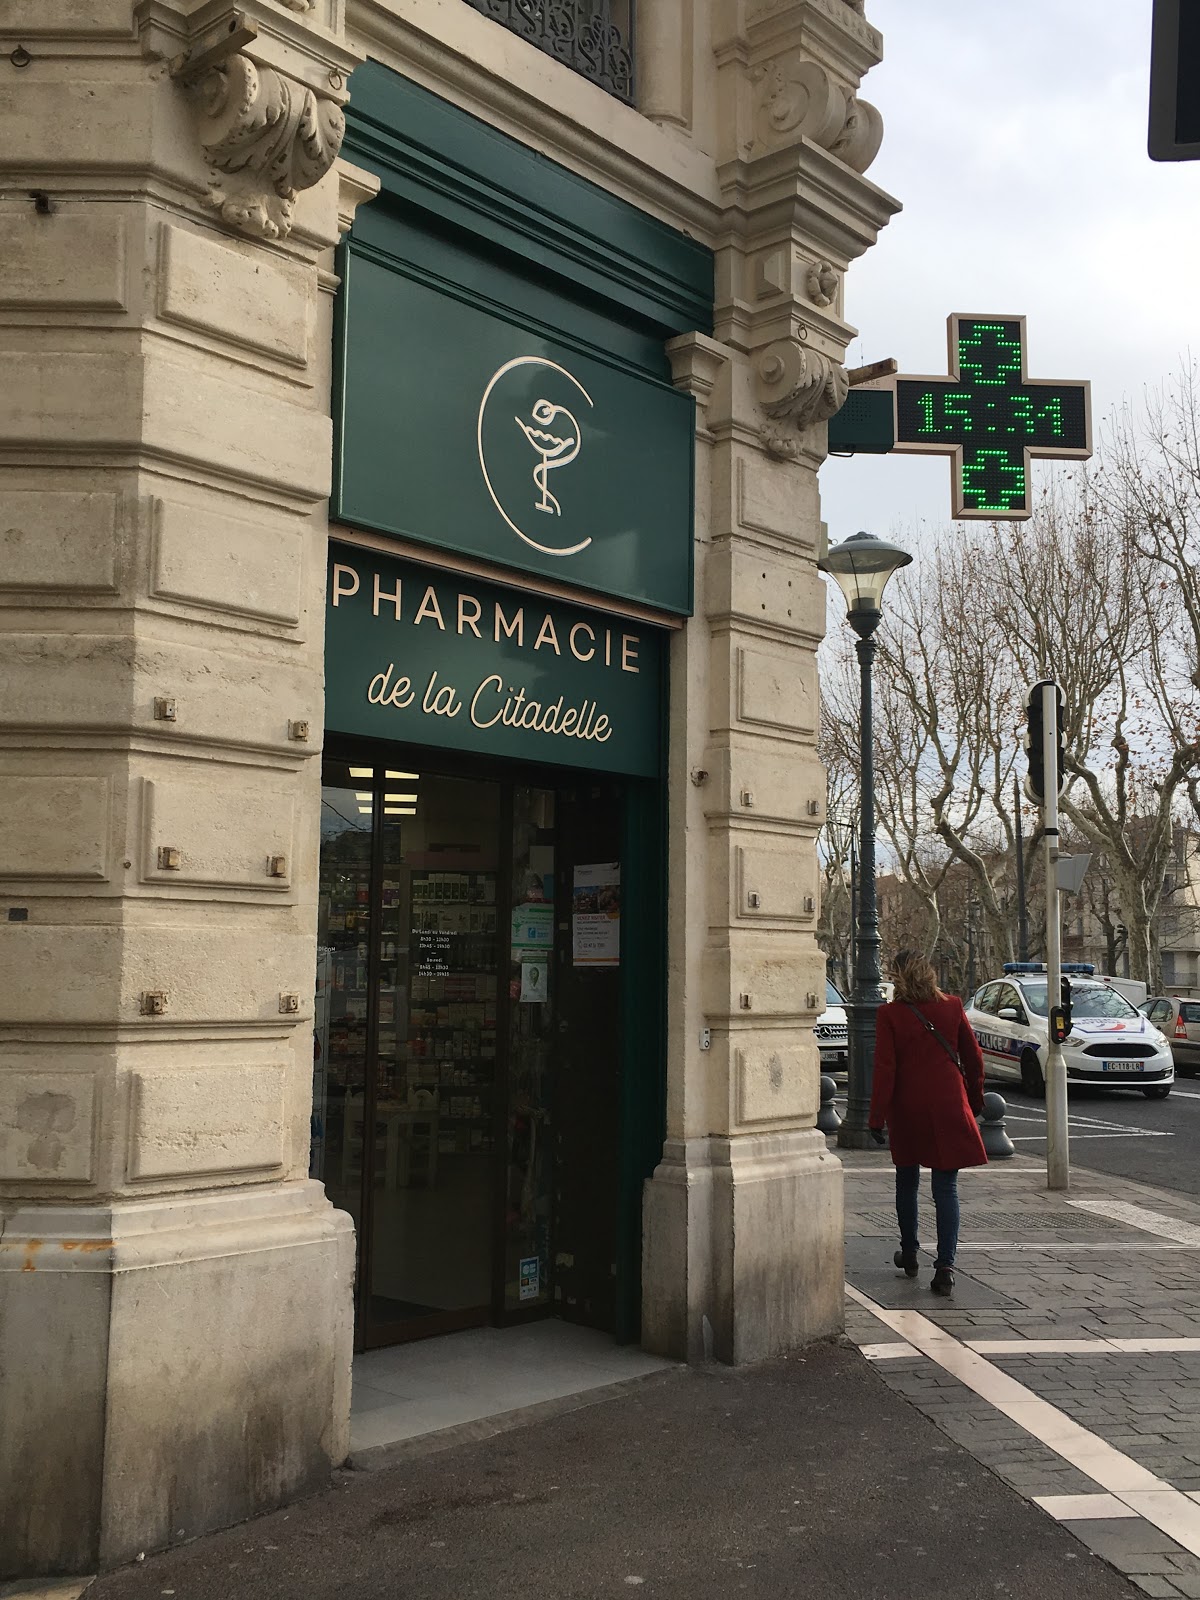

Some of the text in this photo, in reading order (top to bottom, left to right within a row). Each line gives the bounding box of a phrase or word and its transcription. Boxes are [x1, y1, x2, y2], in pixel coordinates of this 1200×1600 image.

[332, 563, 640, 673] PHARMACIE
[367, 663, 613, 743] de la Citadelle
[976, 1032, 1002, 1051] POLICE
